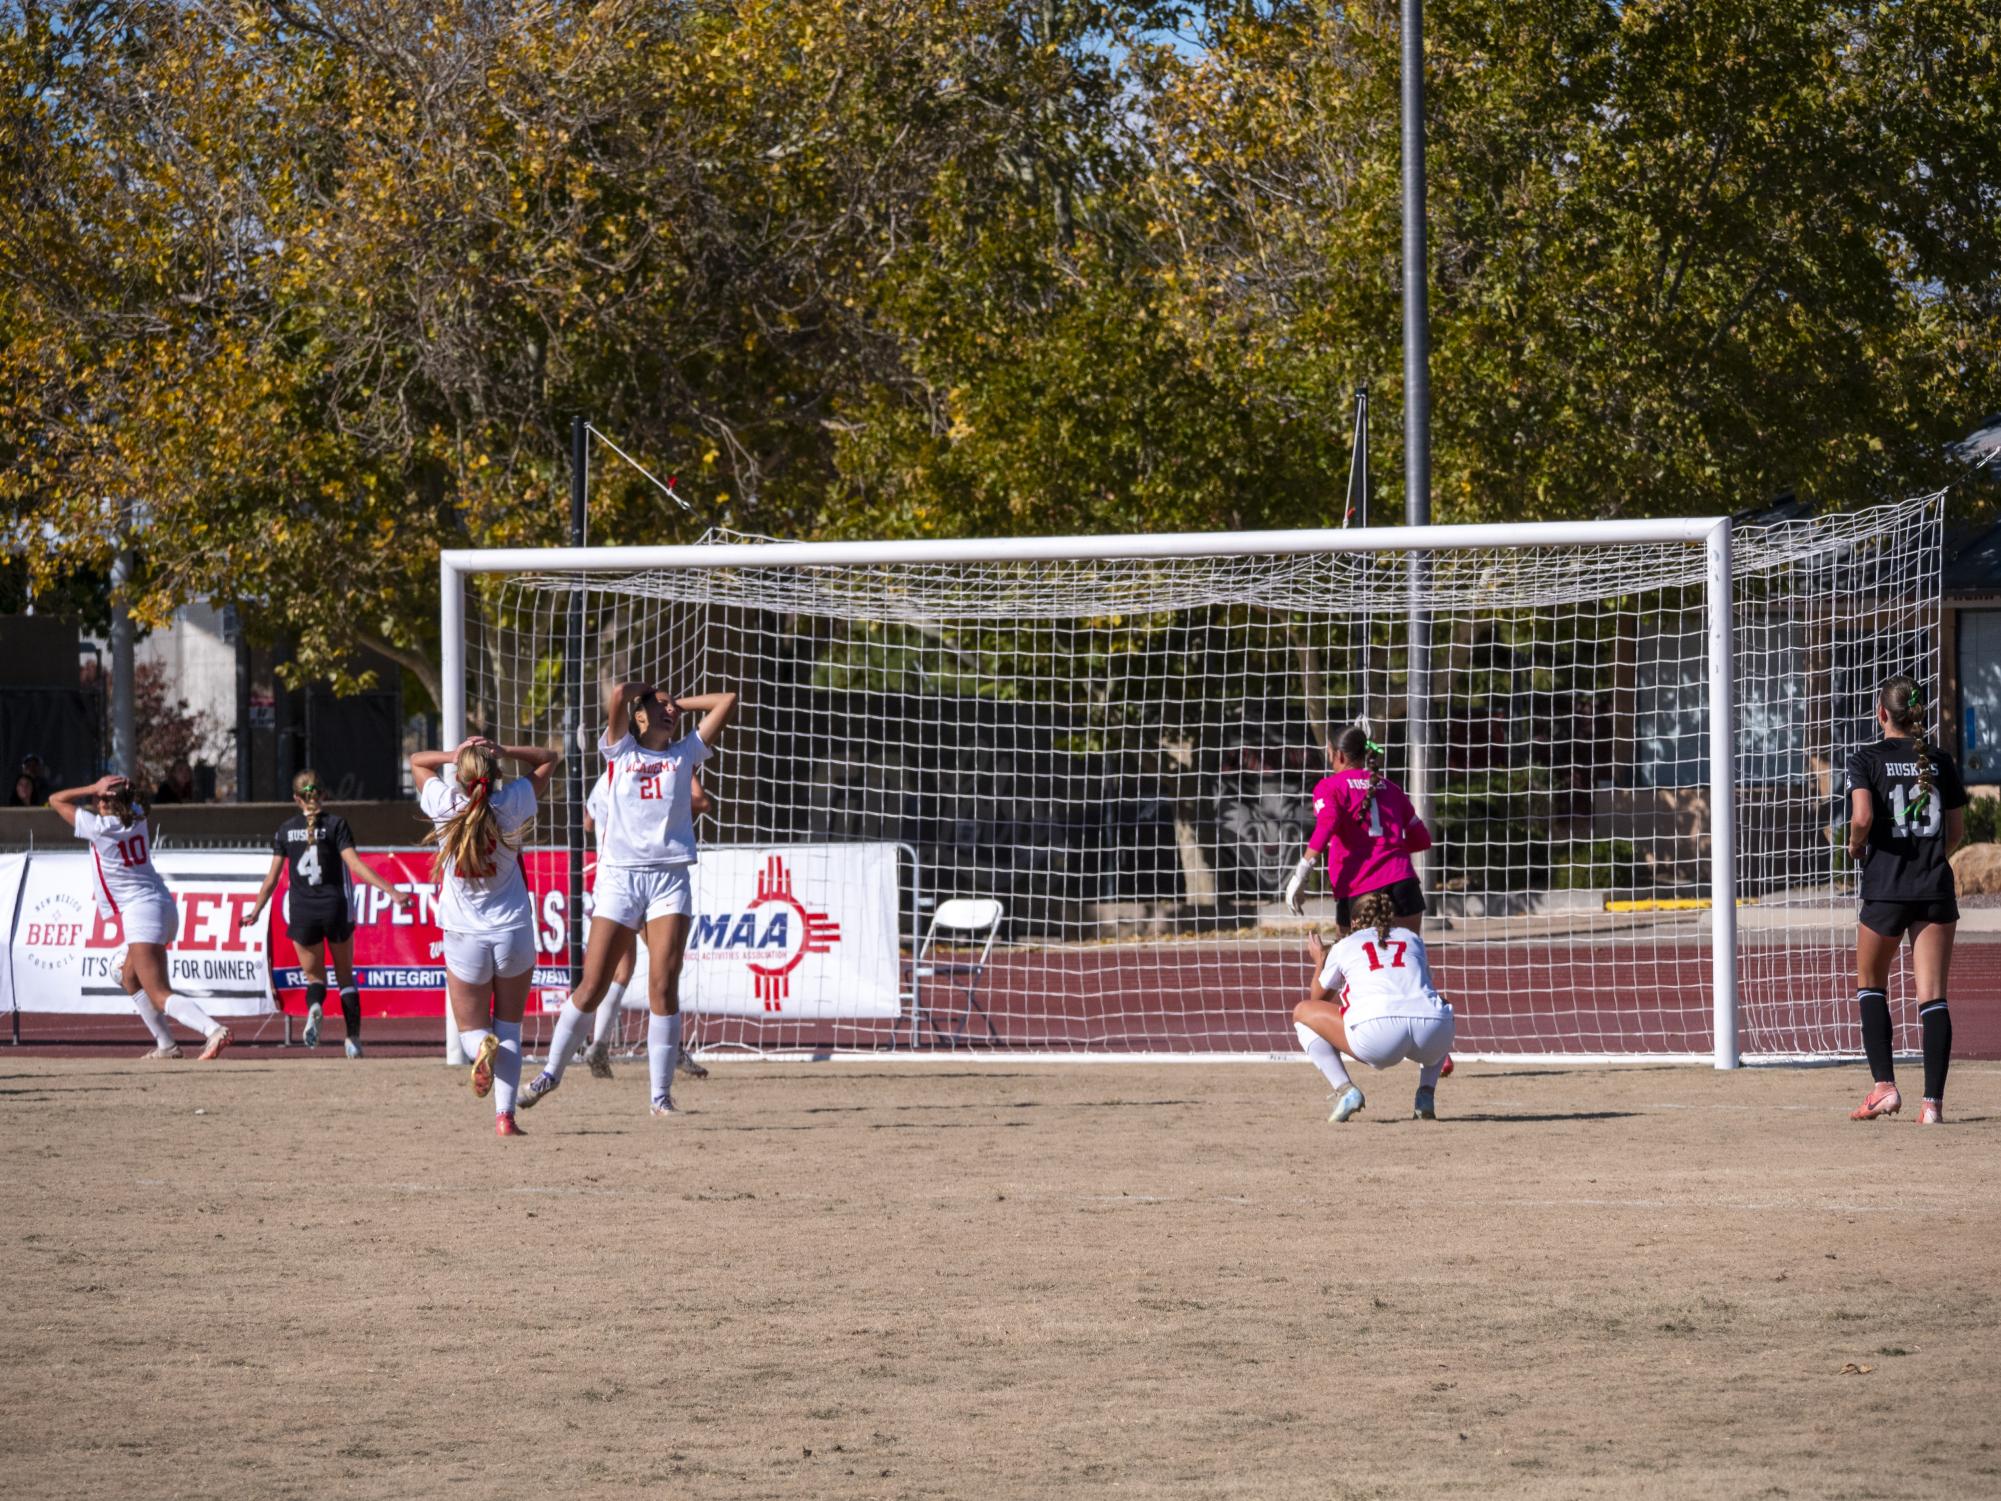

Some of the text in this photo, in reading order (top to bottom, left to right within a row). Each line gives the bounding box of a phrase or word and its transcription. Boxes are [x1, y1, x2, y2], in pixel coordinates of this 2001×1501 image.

[640, 776, 663, 800] 21
[117, 834, 147, 868] 10
[296, 845, 322, 886] 4
[25, 923, 82, 946] BEEF
[691, 912, 788, 949] MAA
[81, 957, 108, 977] IT'S
[172, 960, 201, 980] FOR
[1361, 940, 1408, 972] 17
